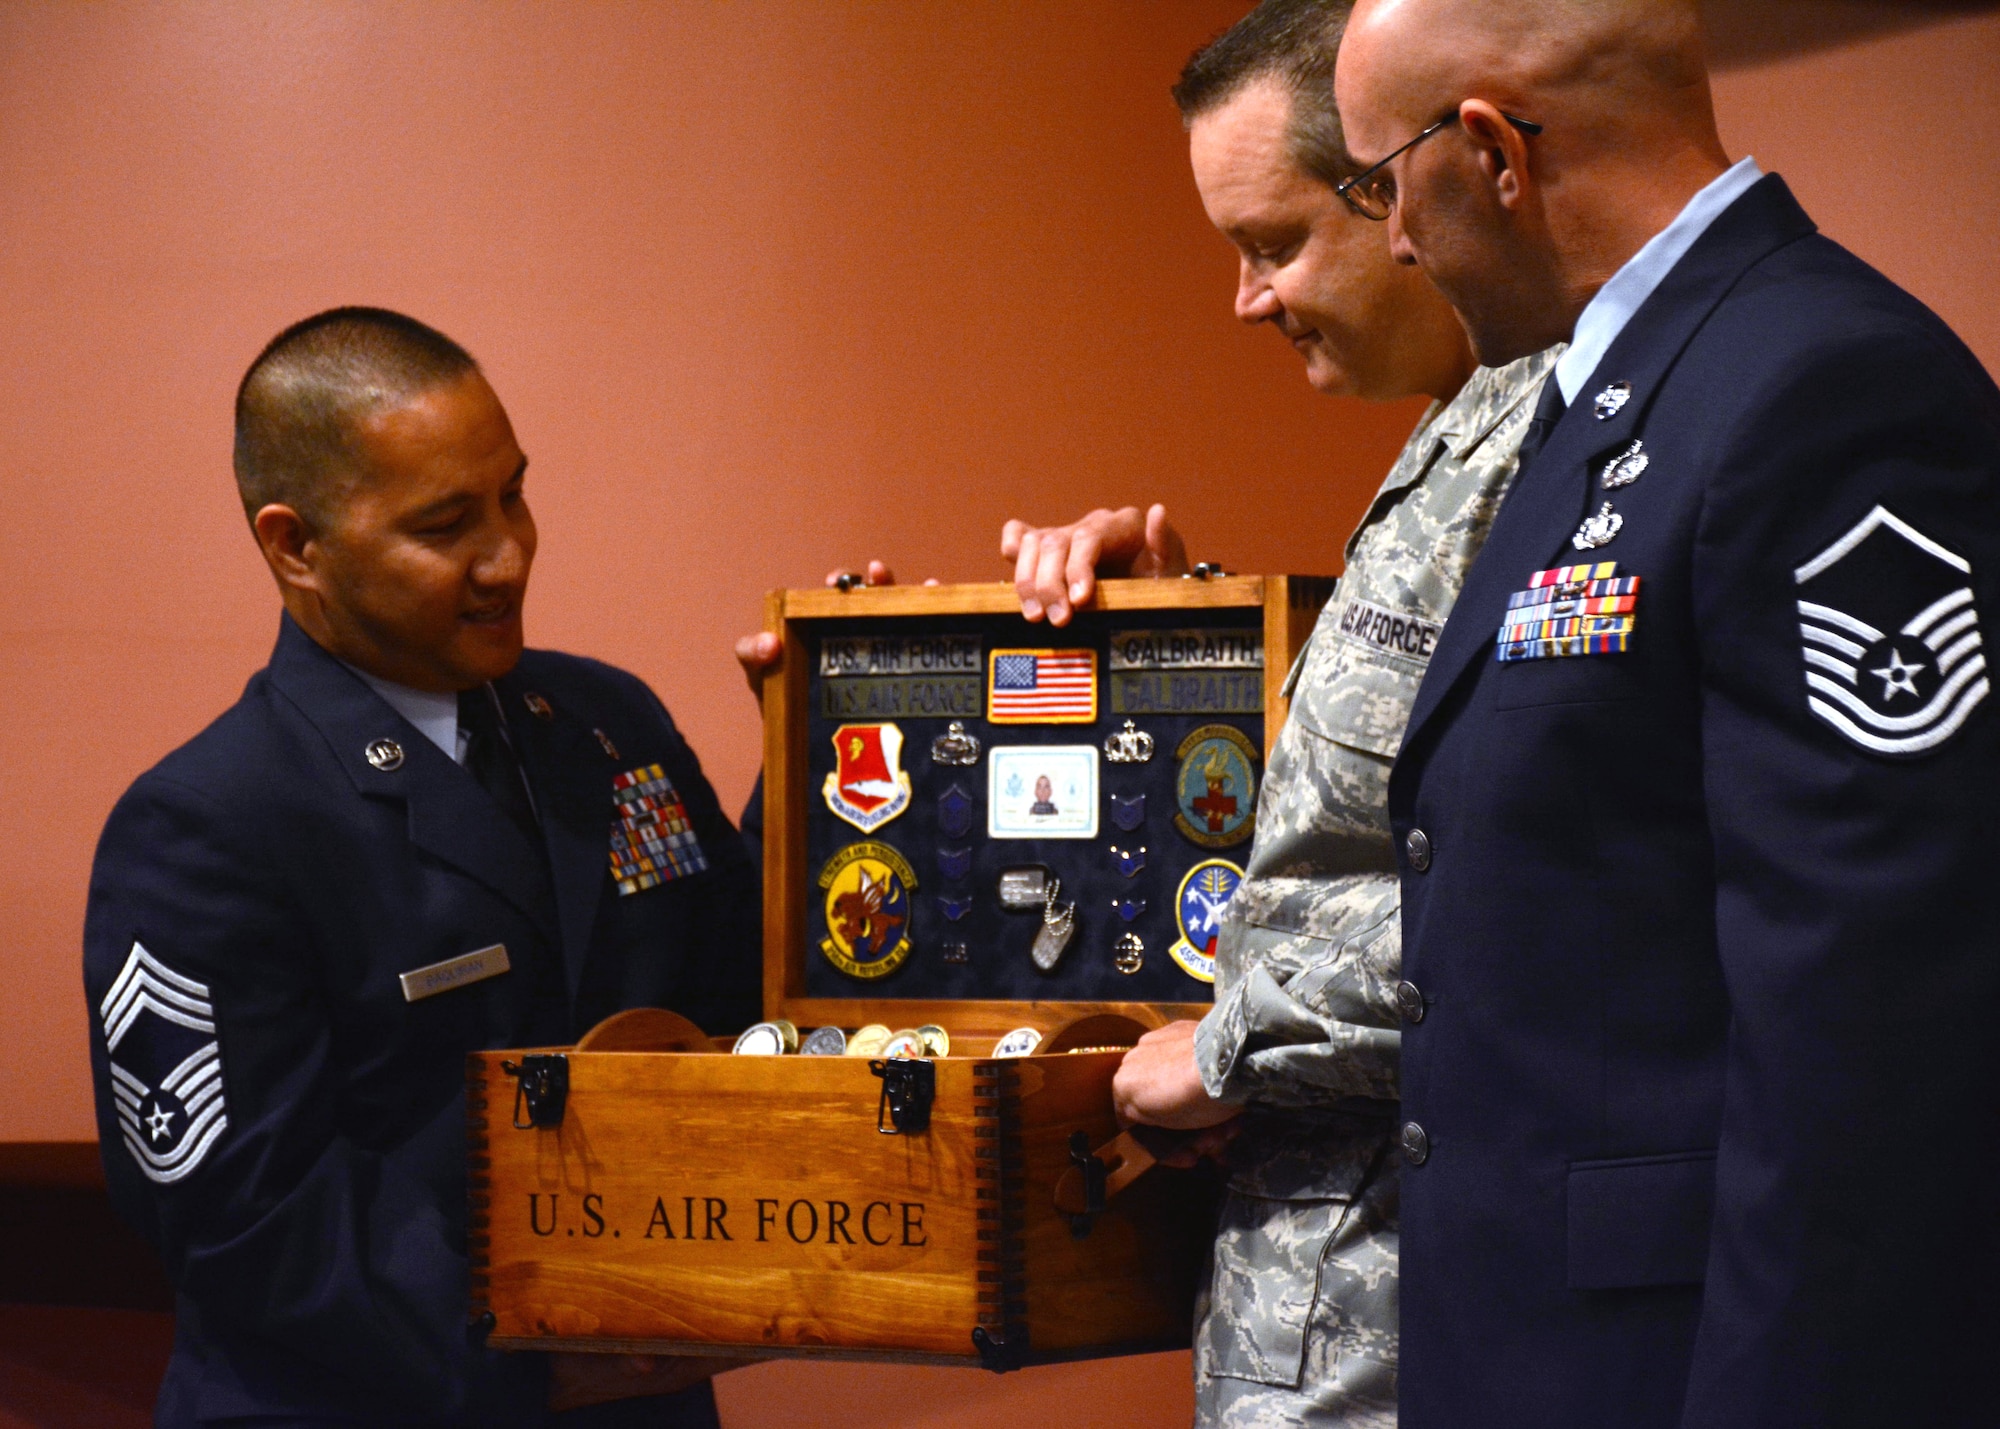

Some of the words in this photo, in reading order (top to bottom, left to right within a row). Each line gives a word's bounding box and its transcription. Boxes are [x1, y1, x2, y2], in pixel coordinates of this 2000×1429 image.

[1125, 636, 1257, 665] GALBRAITH
[1367, 612, 1436, 657] FORCE
[869, 641, 900, 670] AIR
[908, 639, 976, 668] FORCE
[866, 684, 903, 714] AIR
[908, 682, 977, 713] FORCE
[1121, 675, 1261, 712] GALBRAITH
[1179, 946, 1206, 972] 458TH
[528, 1192, 621, 1238] U.S.
[643, 1196, 734, 1241] AIR
[755, 1198, 928, 1247] FORCE
